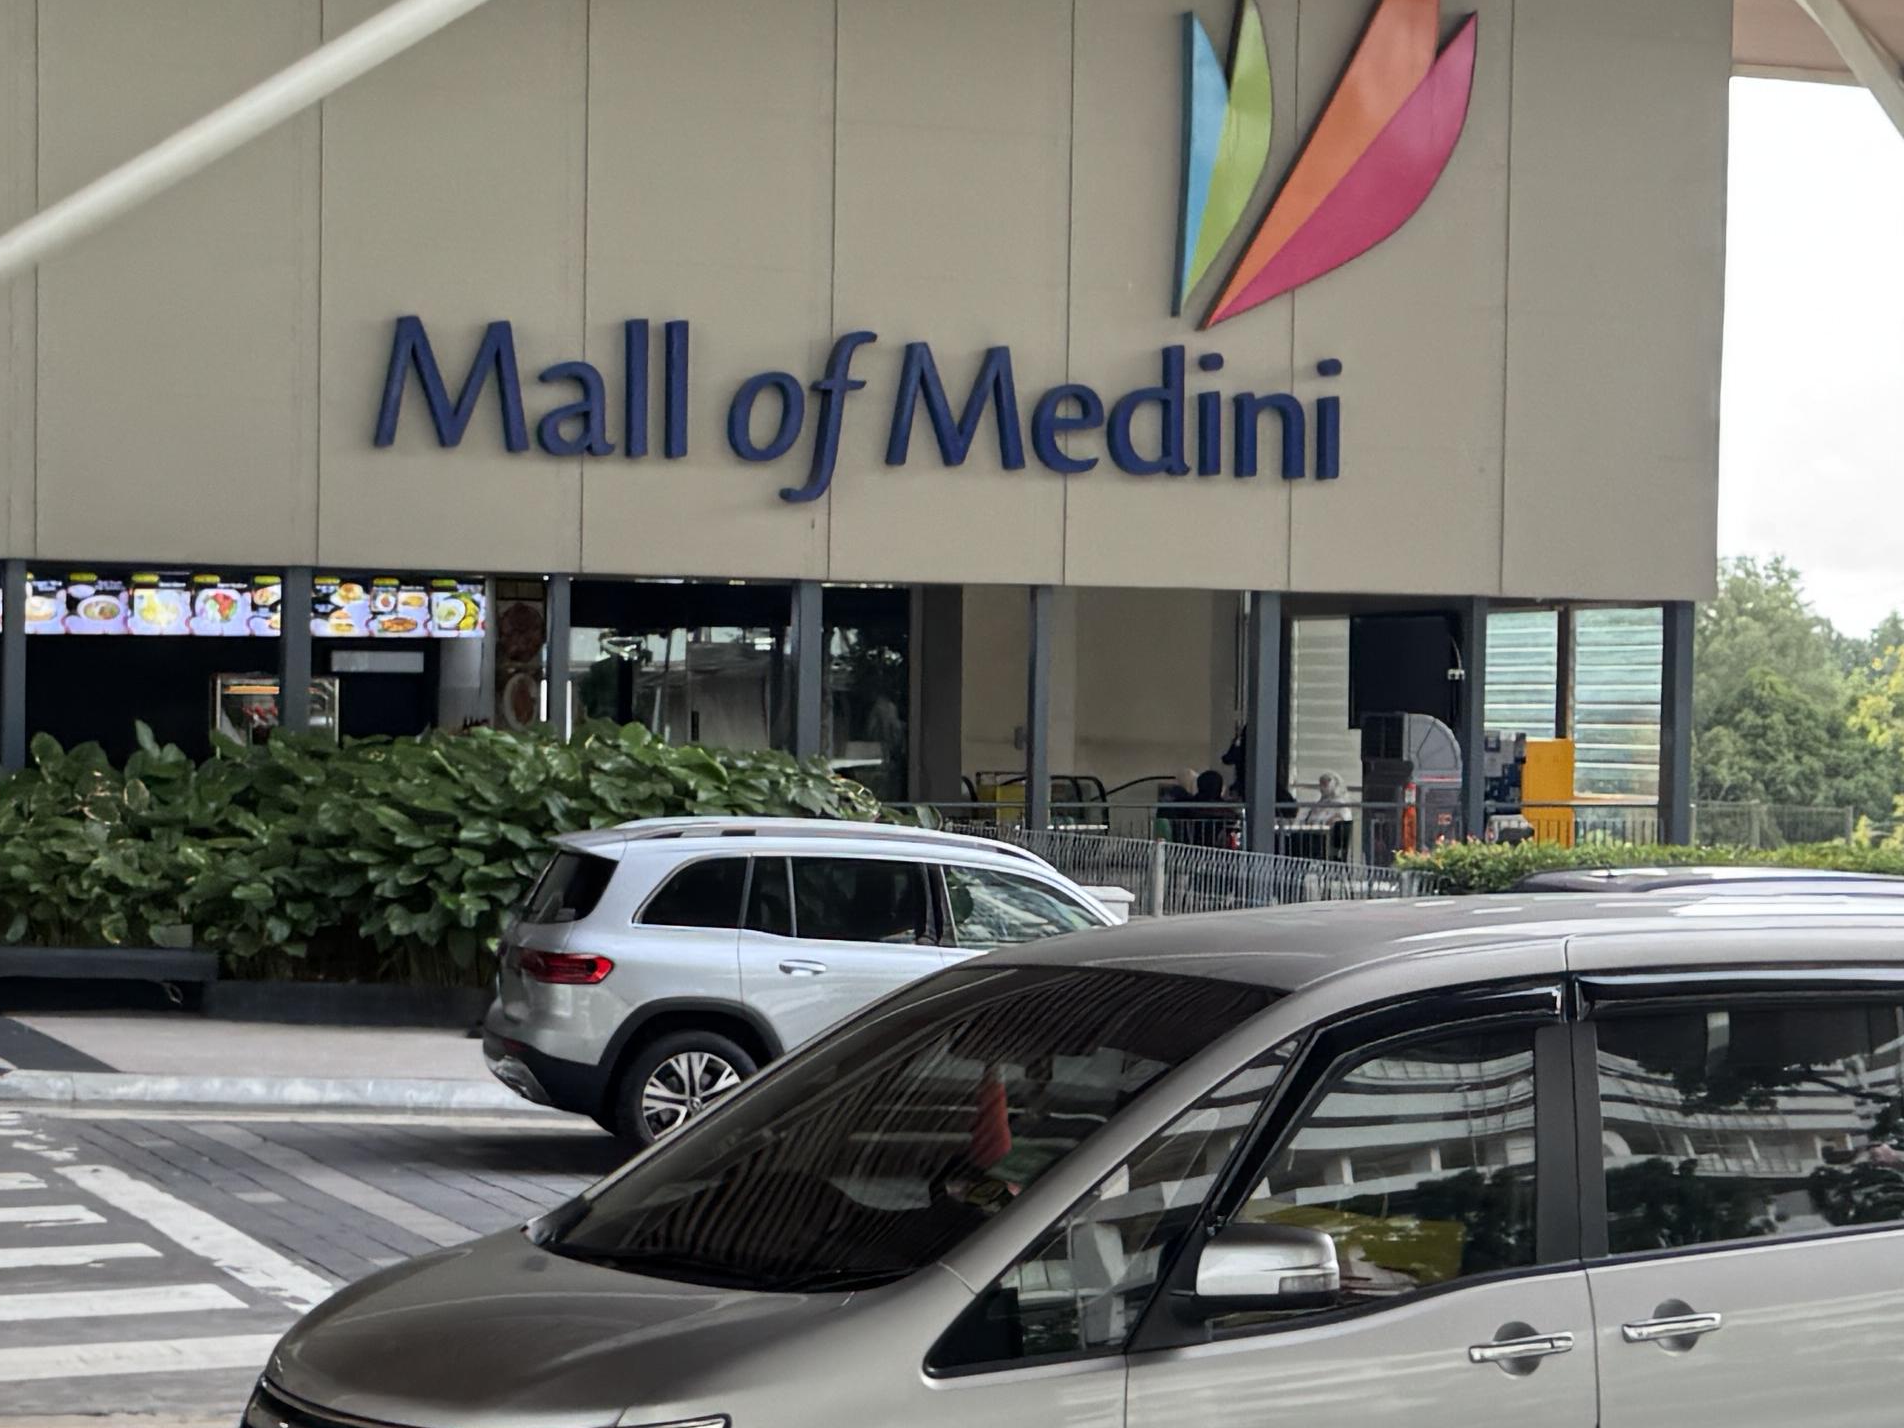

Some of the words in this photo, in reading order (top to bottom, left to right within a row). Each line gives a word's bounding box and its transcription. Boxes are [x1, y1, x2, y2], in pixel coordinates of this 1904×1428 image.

[373, 315, 689, 459] Mall
[727, 330, 878, 502] of
[884, 341, 1343, 480] Medini
